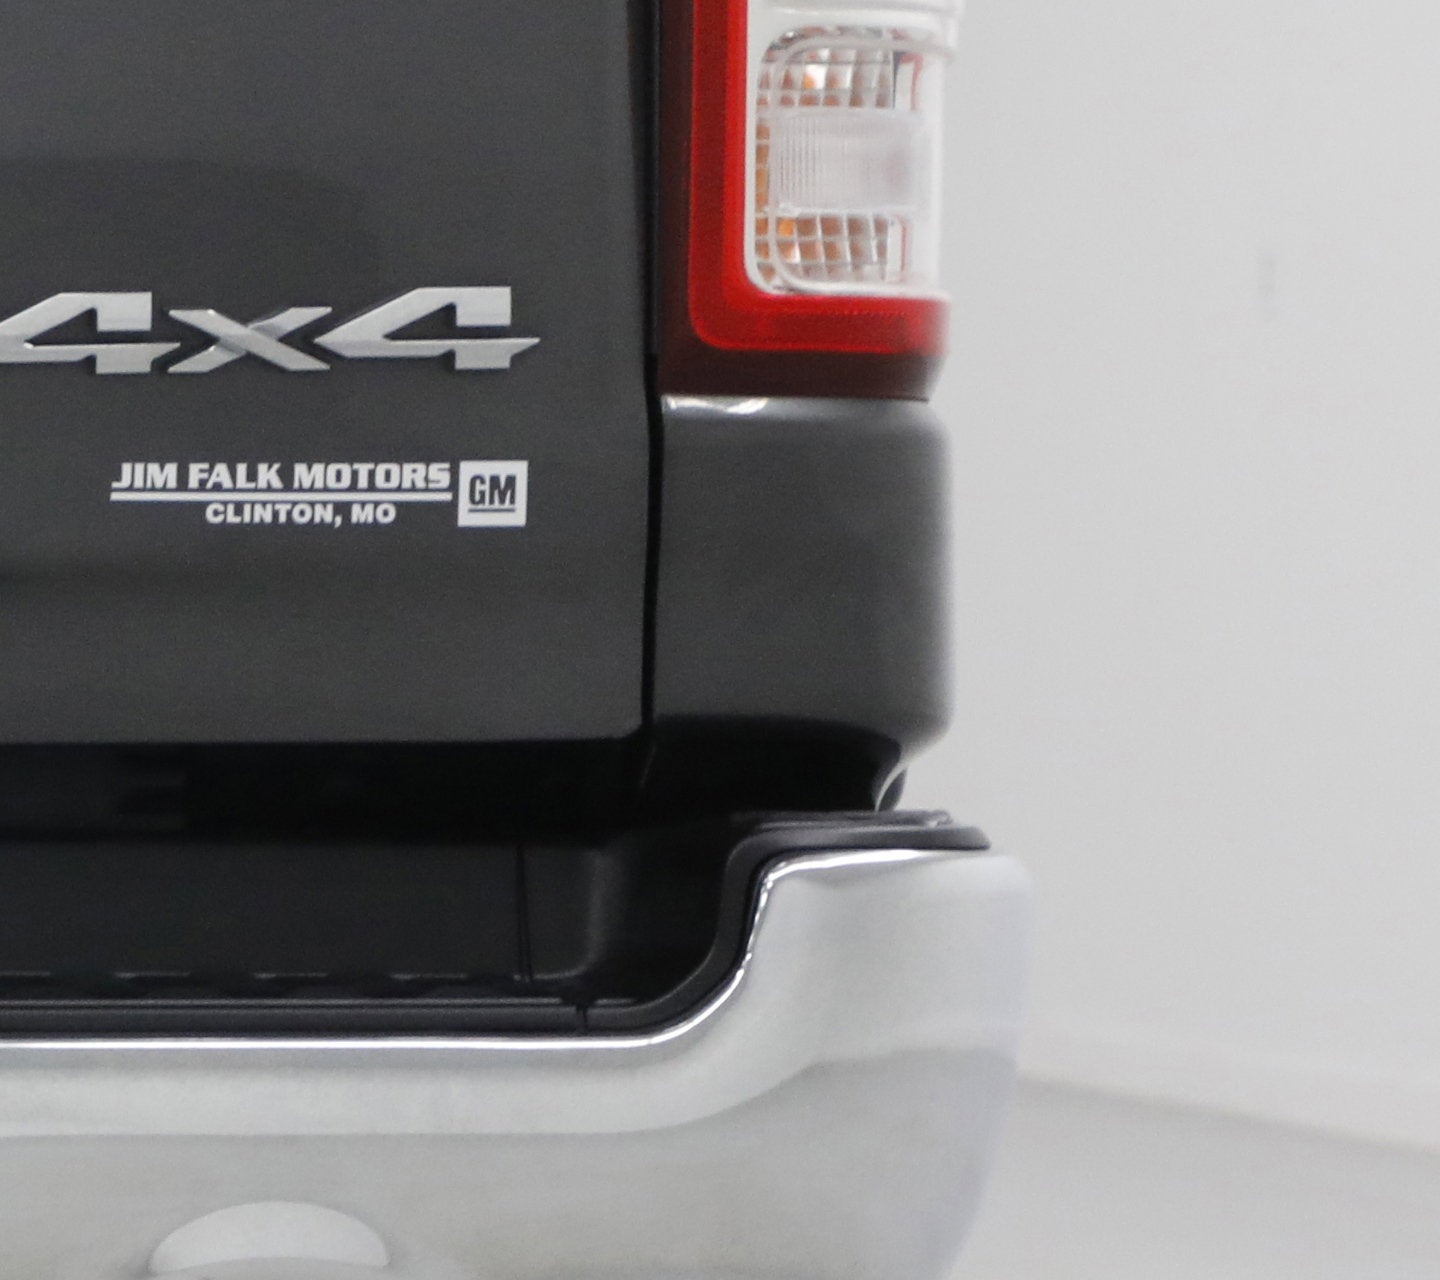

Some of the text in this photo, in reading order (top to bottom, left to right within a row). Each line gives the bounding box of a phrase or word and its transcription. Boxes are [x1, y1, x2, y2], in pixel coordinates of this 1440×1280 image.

[111, 462, 451, 490] JIM FALK MOTORS
[468, 474, 517, 507] GM
[204, 503, 397, 528] CLINTON, MO
